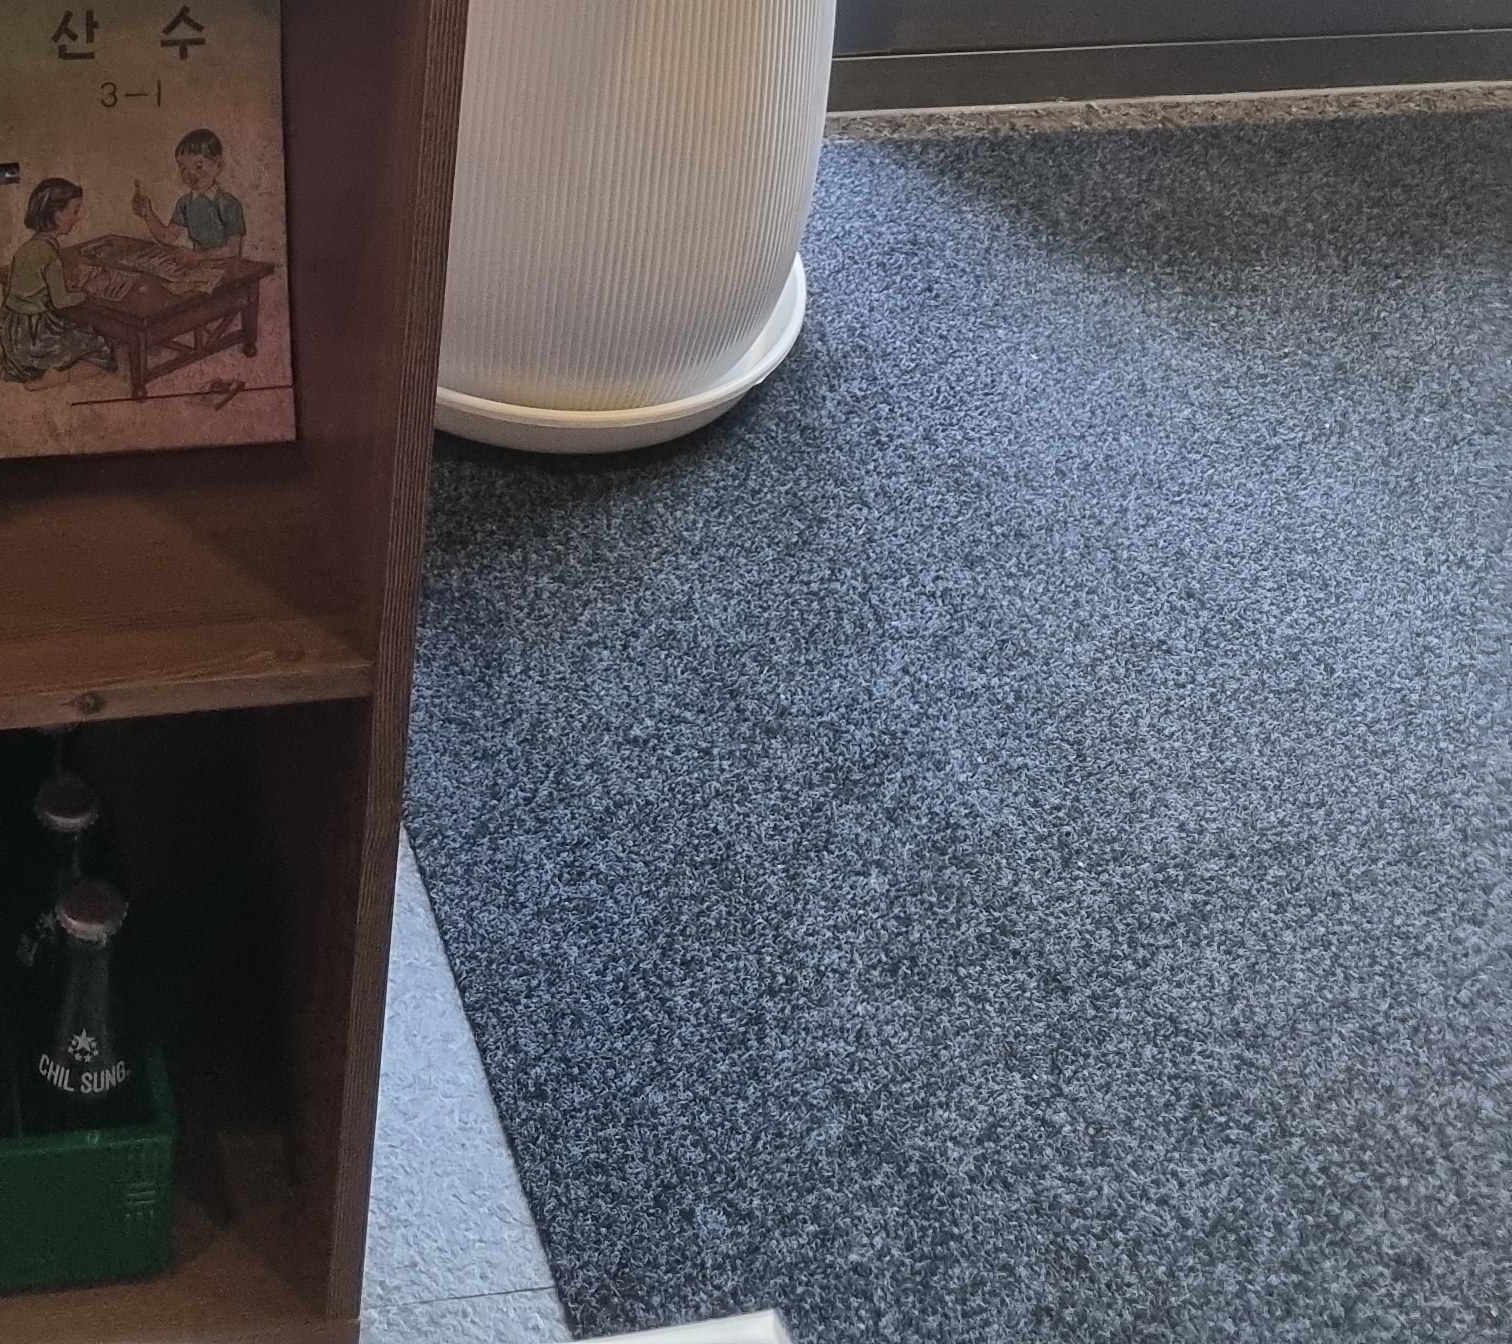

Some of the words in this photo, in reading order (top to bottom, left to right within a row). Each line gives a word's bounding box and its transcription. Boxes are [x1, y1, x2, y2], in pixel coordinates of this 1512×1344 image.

[50, 9, 101, 61] 산
[159, 5, 206, 61] 수
[38, 1053, 75, 1092] CHIL
[80, 1059, 127, 1094] SUNG
